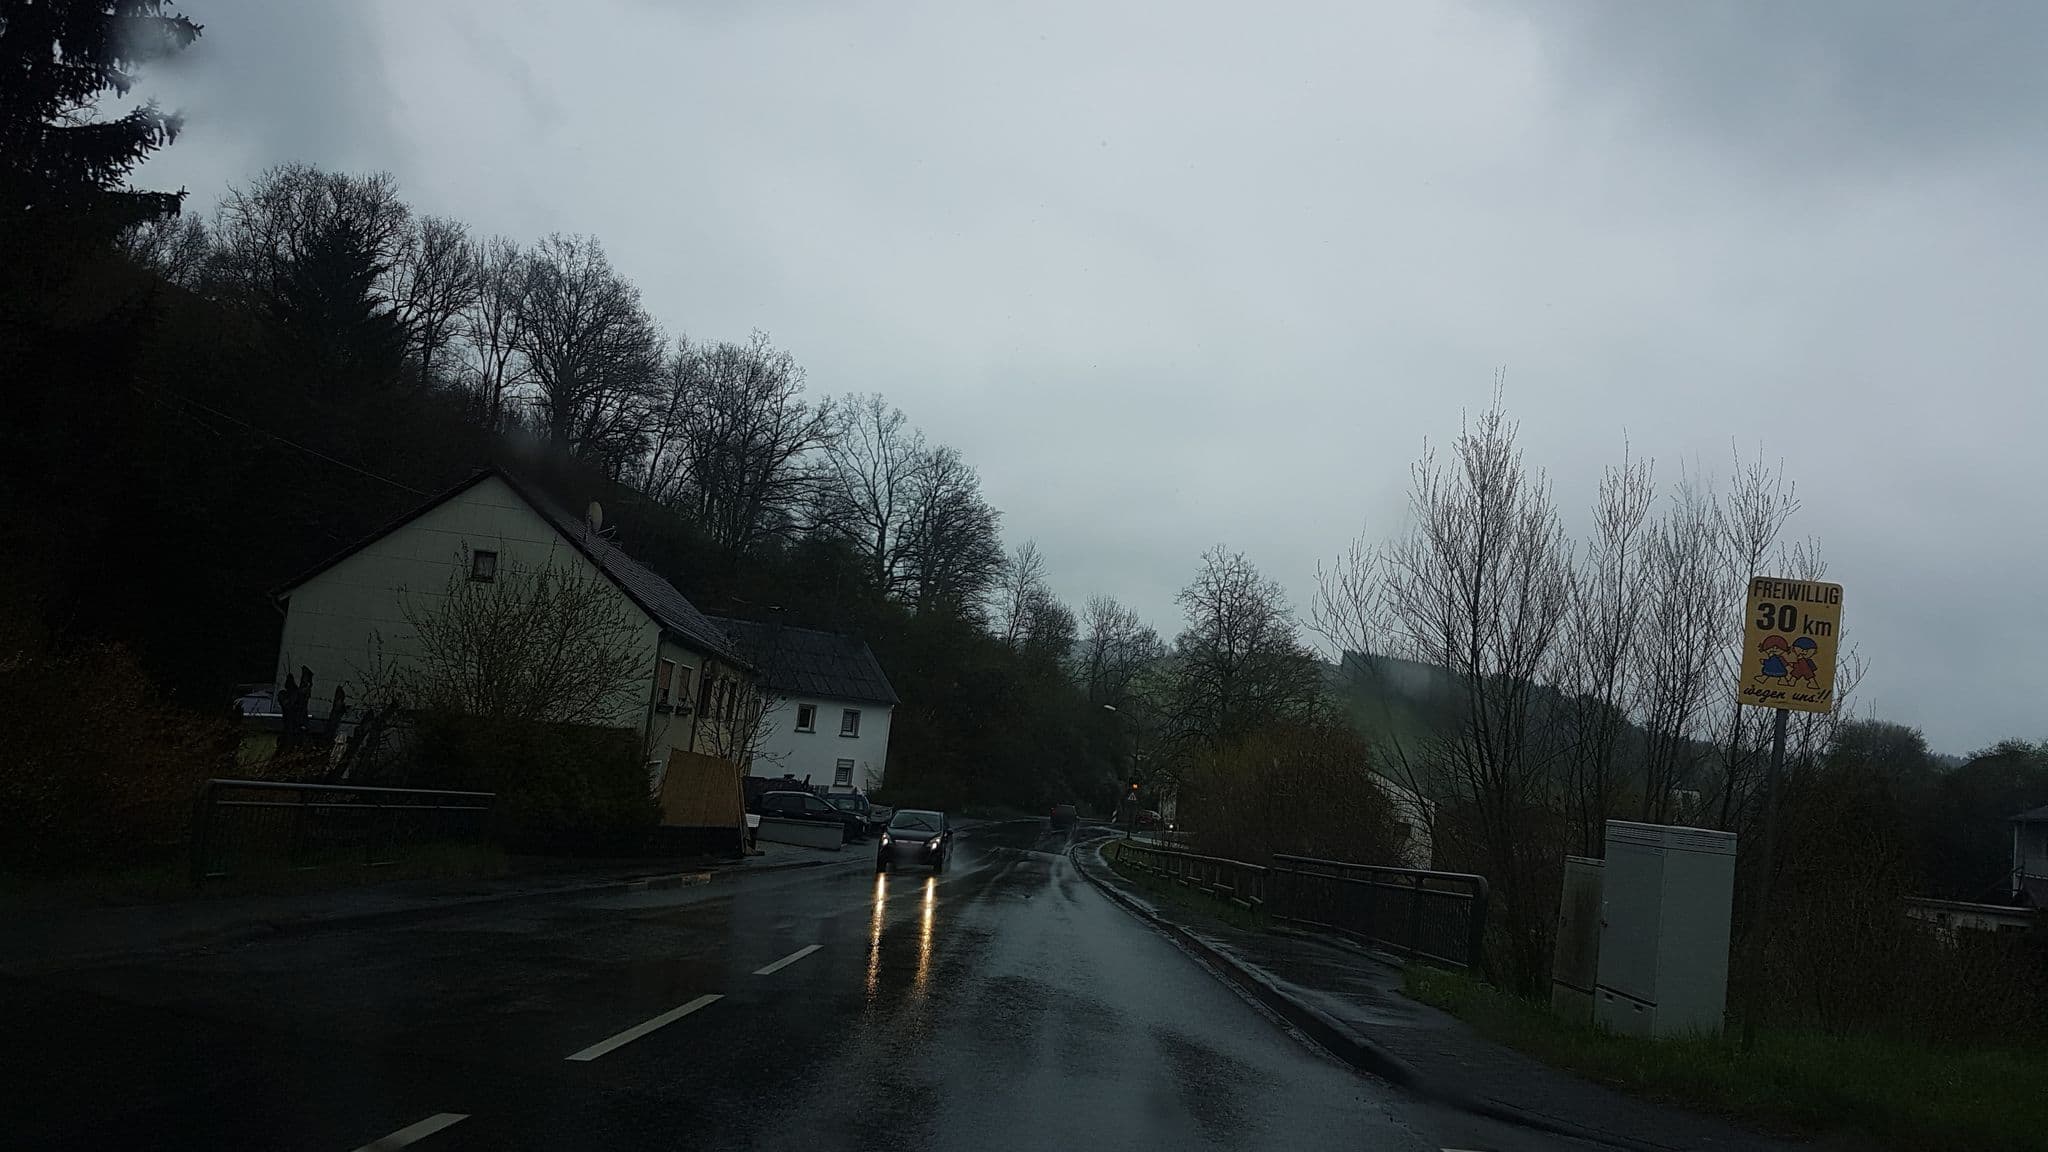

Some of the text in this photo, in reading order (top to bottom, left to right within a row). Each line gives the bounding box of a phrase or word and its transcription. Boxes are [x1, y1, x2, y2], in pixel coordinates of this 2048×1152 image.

[1754, 580, 1839, 604] FREIWILLIG
[1756, 603, 1831, 636] 30 km
[1743, 686, 1786, 703] wegen
